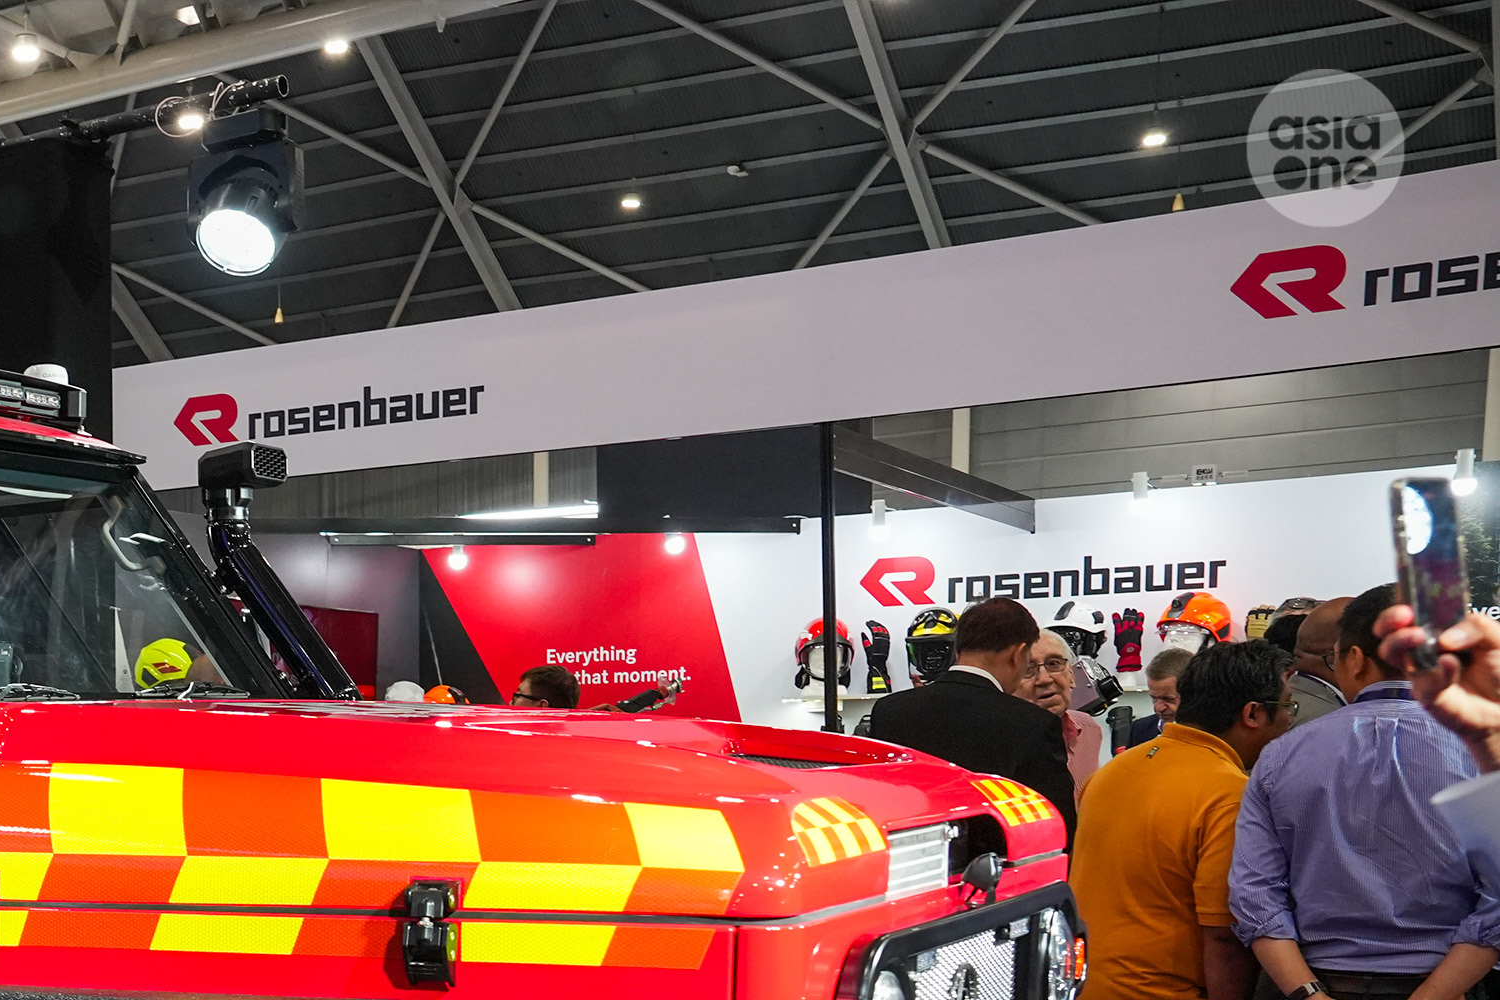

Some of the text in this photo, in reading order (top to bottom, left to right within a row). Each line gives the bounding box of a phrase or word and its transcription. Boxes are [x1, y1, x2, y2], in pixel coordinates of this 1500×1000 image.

[248, 385, 485, 440] rosenbauer
[948, 555, 1227, 604] rosenbauer
[546, 645, 637, 666] Everything
[574, 666, 692, 685] that moment.
